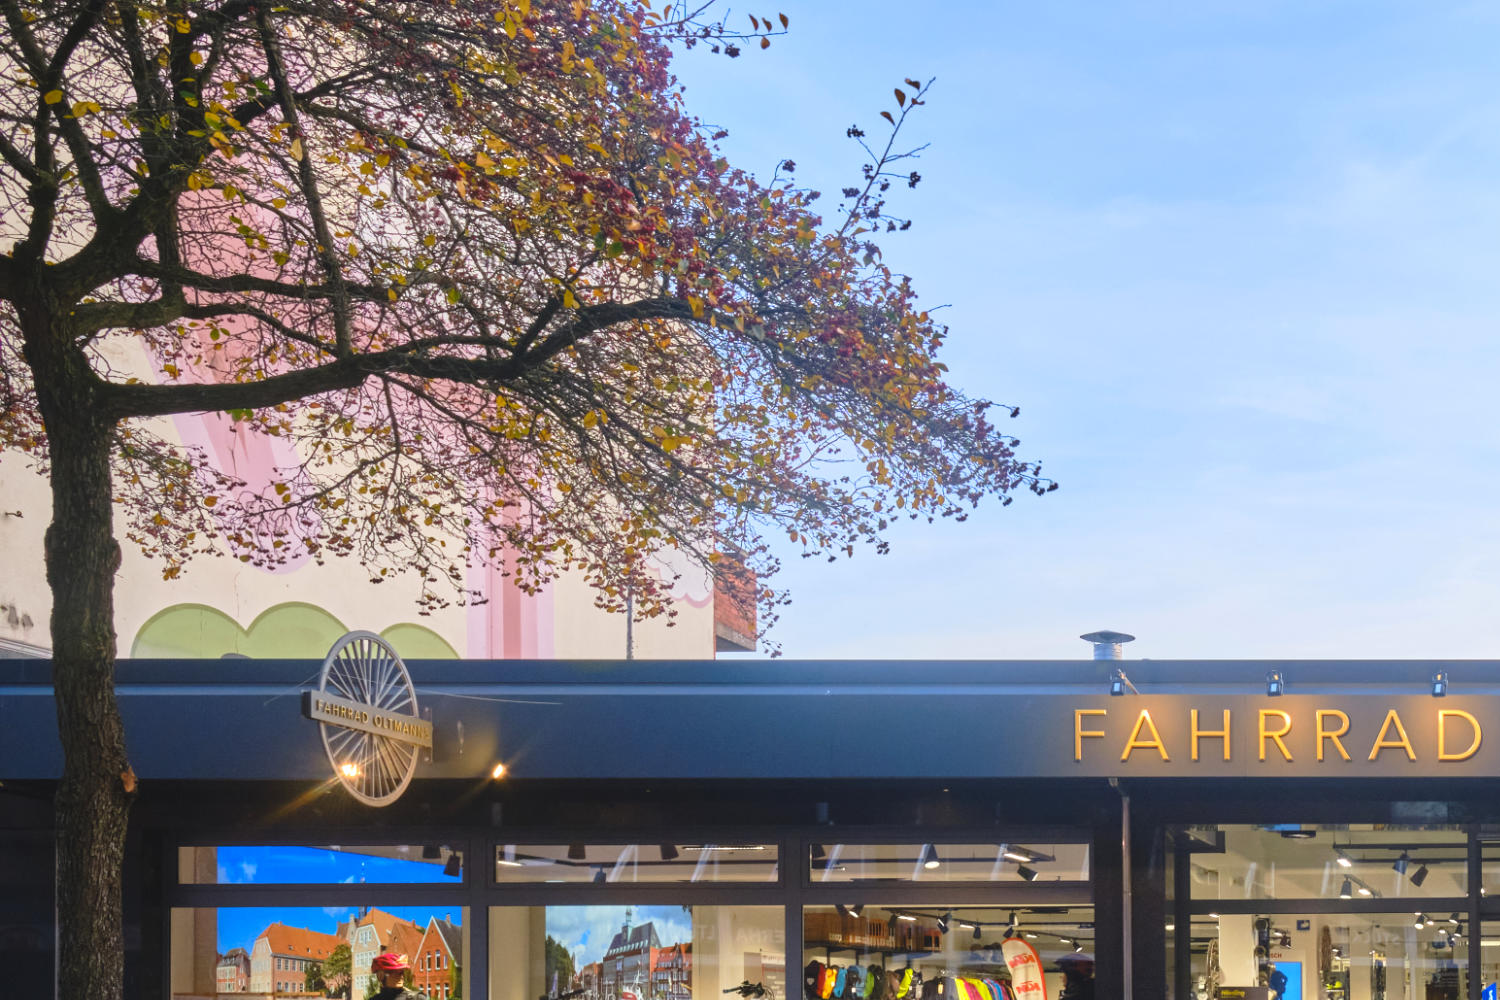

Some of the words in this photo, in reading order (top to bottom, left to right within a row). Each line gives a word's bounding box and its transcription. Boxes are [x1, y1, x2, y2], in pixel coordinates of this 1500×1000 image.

[316, 700, 369, 724] FAHRRAD
[373, 714, 430, 740] OLTMANNS
[1073, 708, 1483, 762] FAHRRAD
